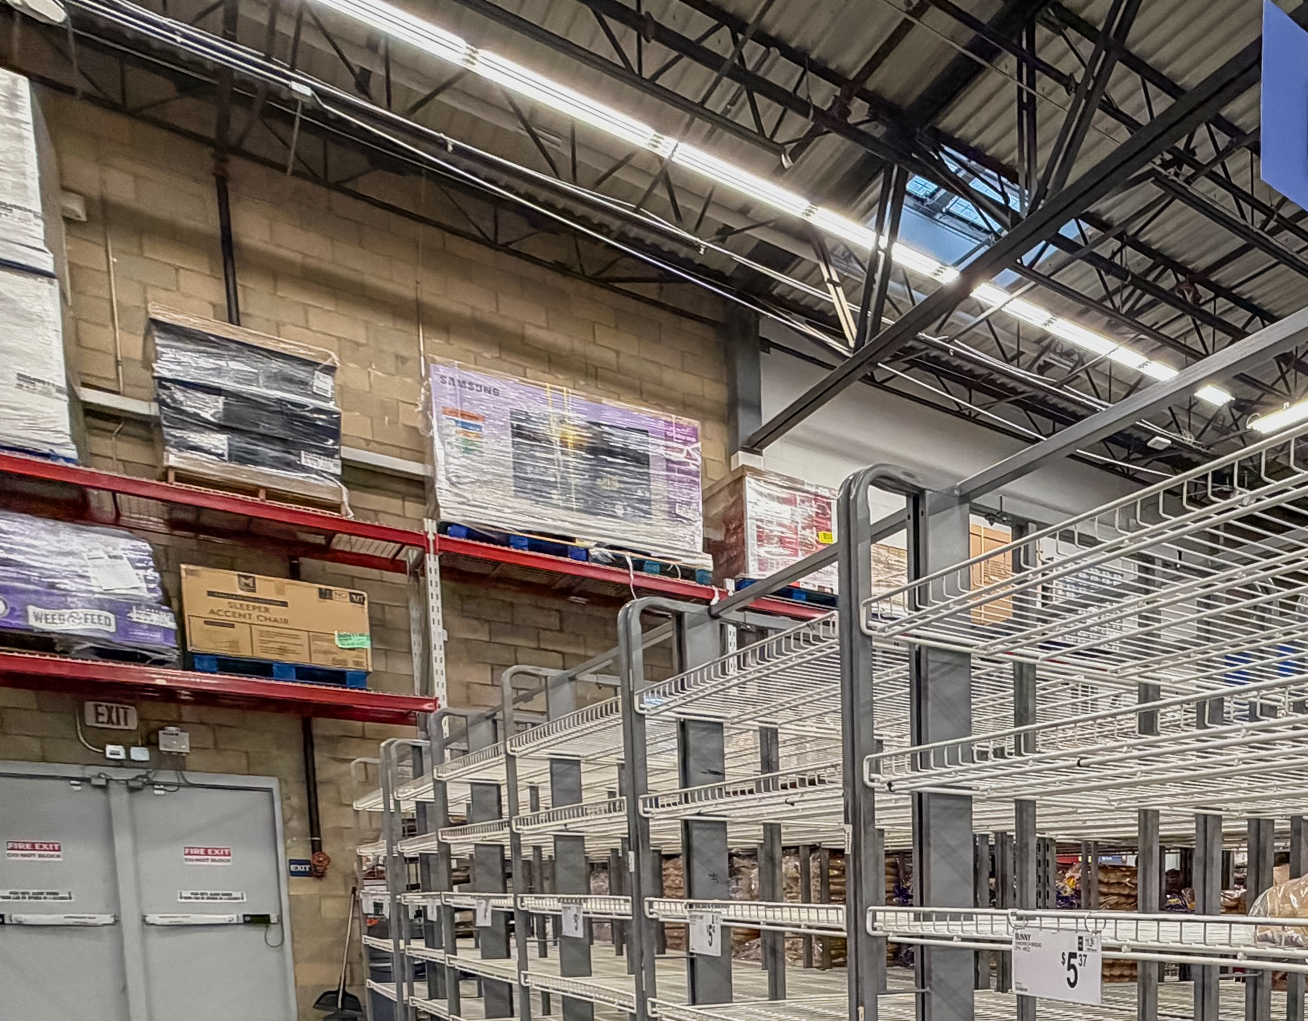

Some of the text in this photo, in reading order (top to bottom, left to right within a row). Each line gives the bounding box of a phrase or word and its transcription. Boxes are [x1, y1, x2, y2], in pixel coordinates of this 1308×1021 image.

[439, 374, 500, 397] SAMSUNG
[227, 601, 270, 614] SLEEPER
[33, 611, 65, 625] WEED
[83, 614, 112, 627] FEED
[209, 608, 289, 625] ACCENT CHAIR
[93, 703, 130, 727] EXIT
[7, 842, 60, 851] FIRE EXIT
[208, 848, 231, 856] EXIT
[290, 864, 310, 872] EXIT
